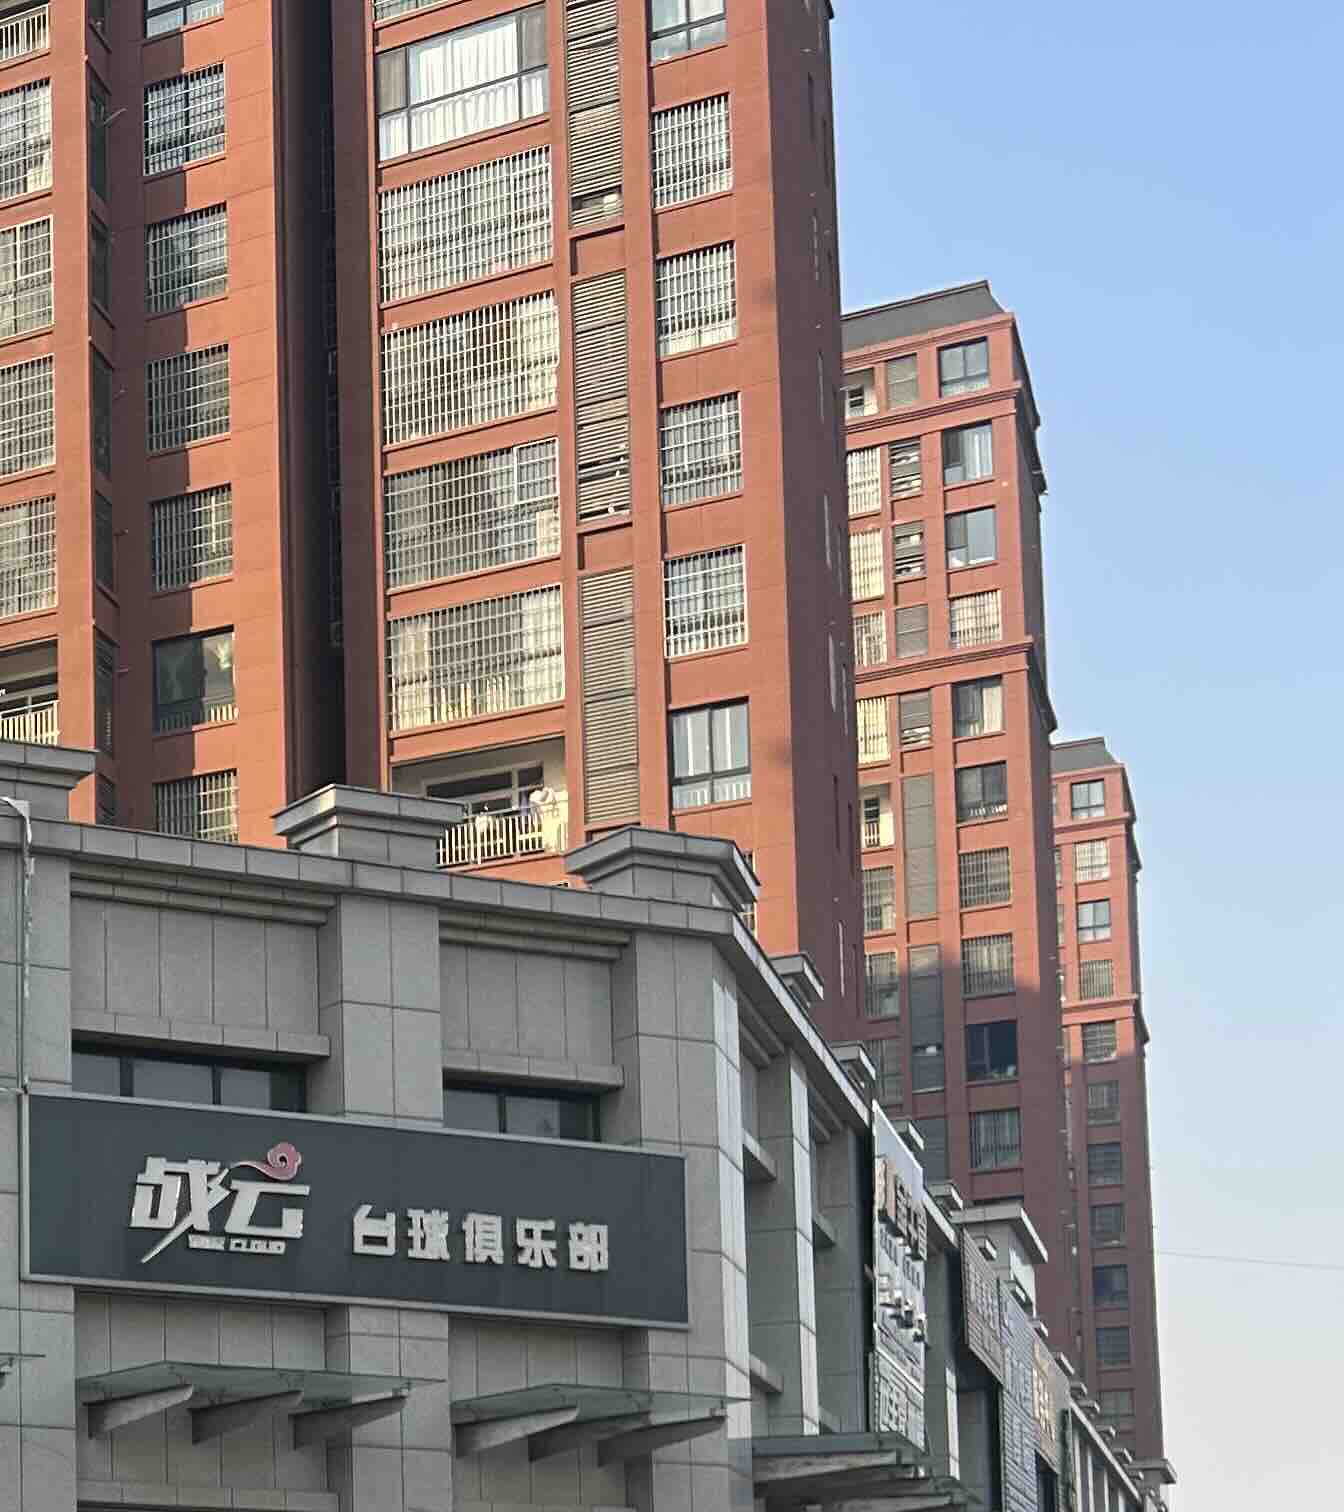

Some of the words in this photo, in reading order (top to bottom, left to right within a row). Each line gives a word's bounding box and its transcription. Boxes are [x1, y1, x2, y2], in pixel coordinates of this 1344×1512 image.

[129, 1142, 311, 1264] 战云
[352, 1203, 609, 1273] 台球俱乐部
